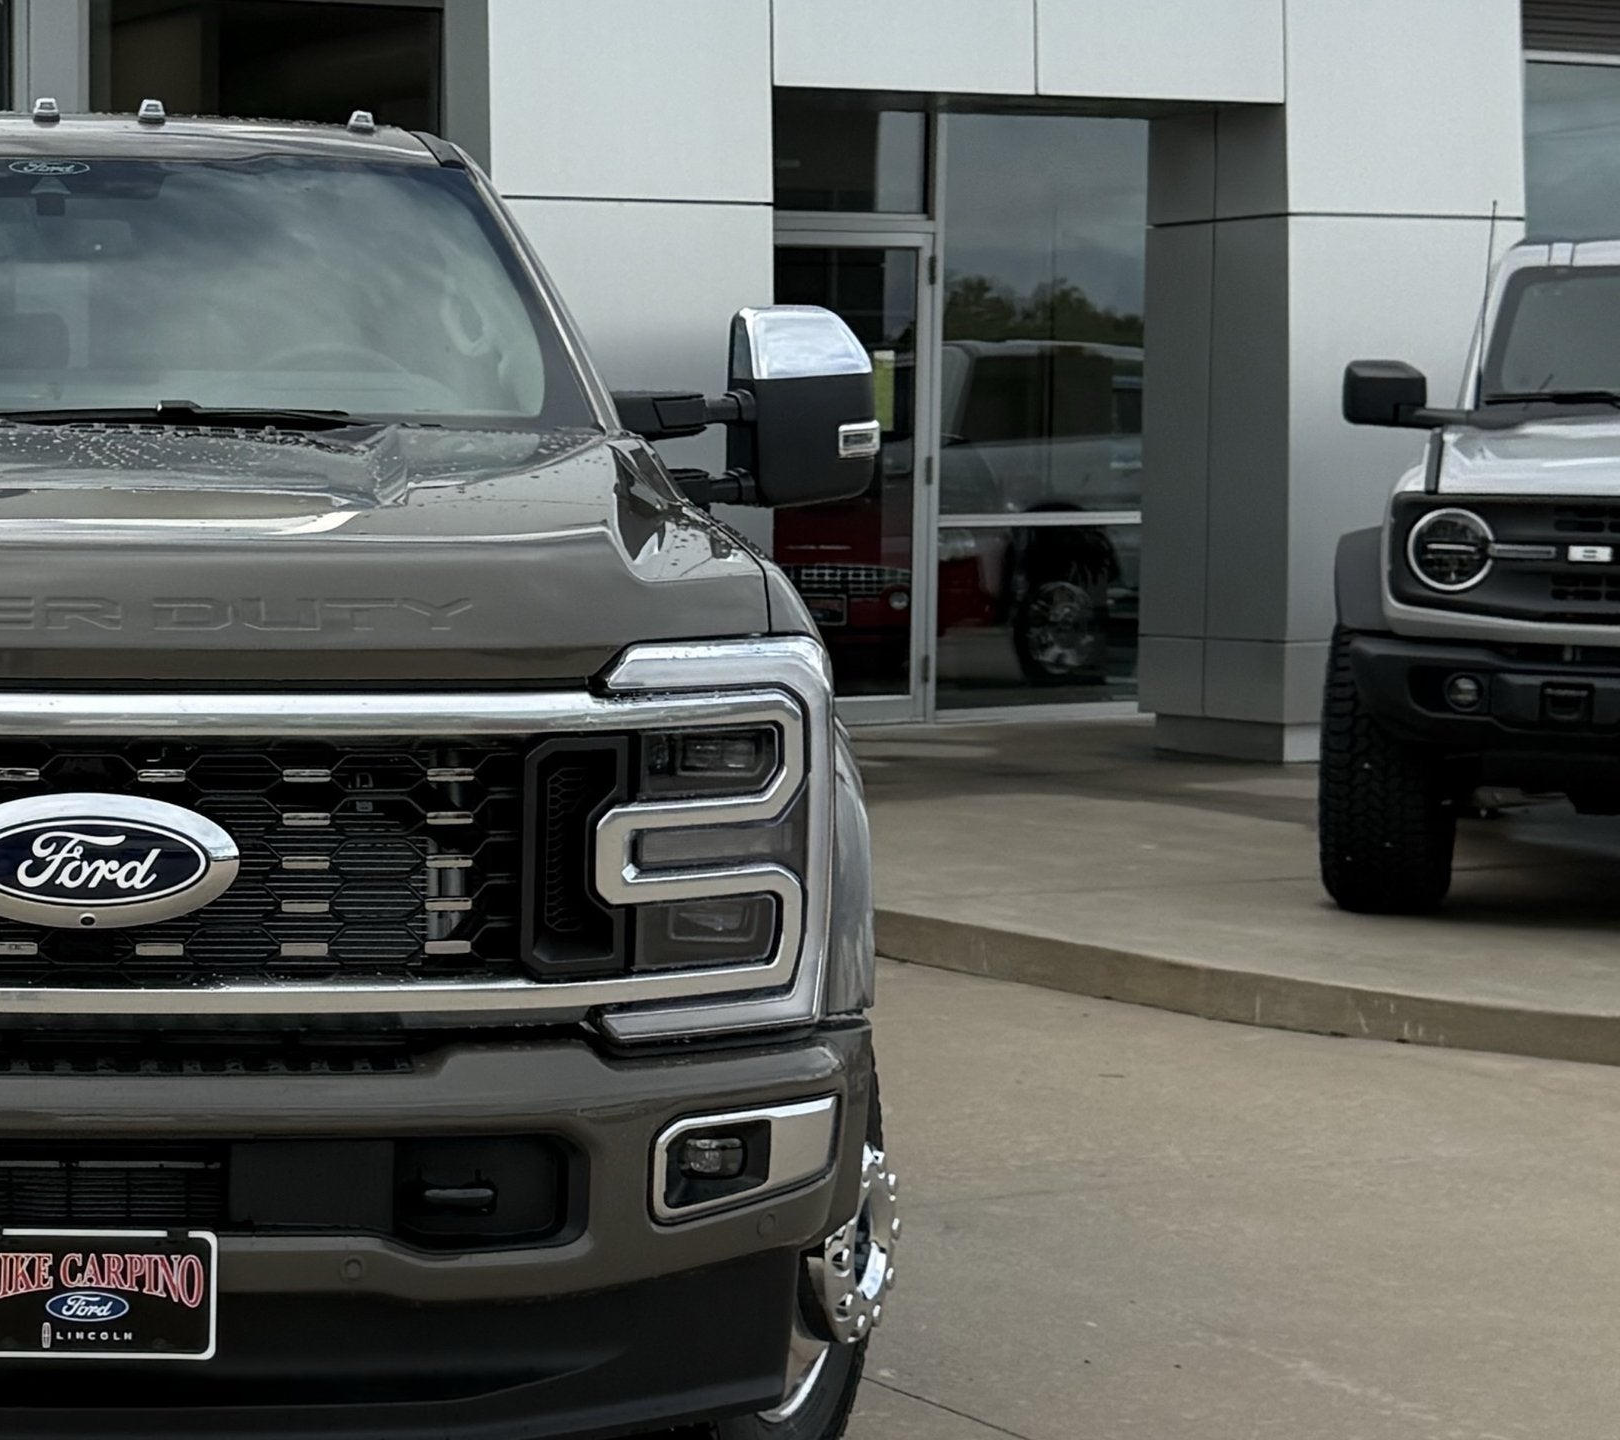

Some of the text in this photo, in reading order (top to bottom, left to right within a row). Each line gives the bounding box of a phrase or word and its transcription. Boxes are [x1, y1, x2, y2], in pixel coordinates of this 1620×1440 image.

[152, 596, 474, 631] DUTY
[16, 831, 162, 890] Ford
[59, 1252, 205, 1309] CARPINO
[61, 1295, 113, 1317] Ford
[55, 1331, 133, 1341] LINCOLN
